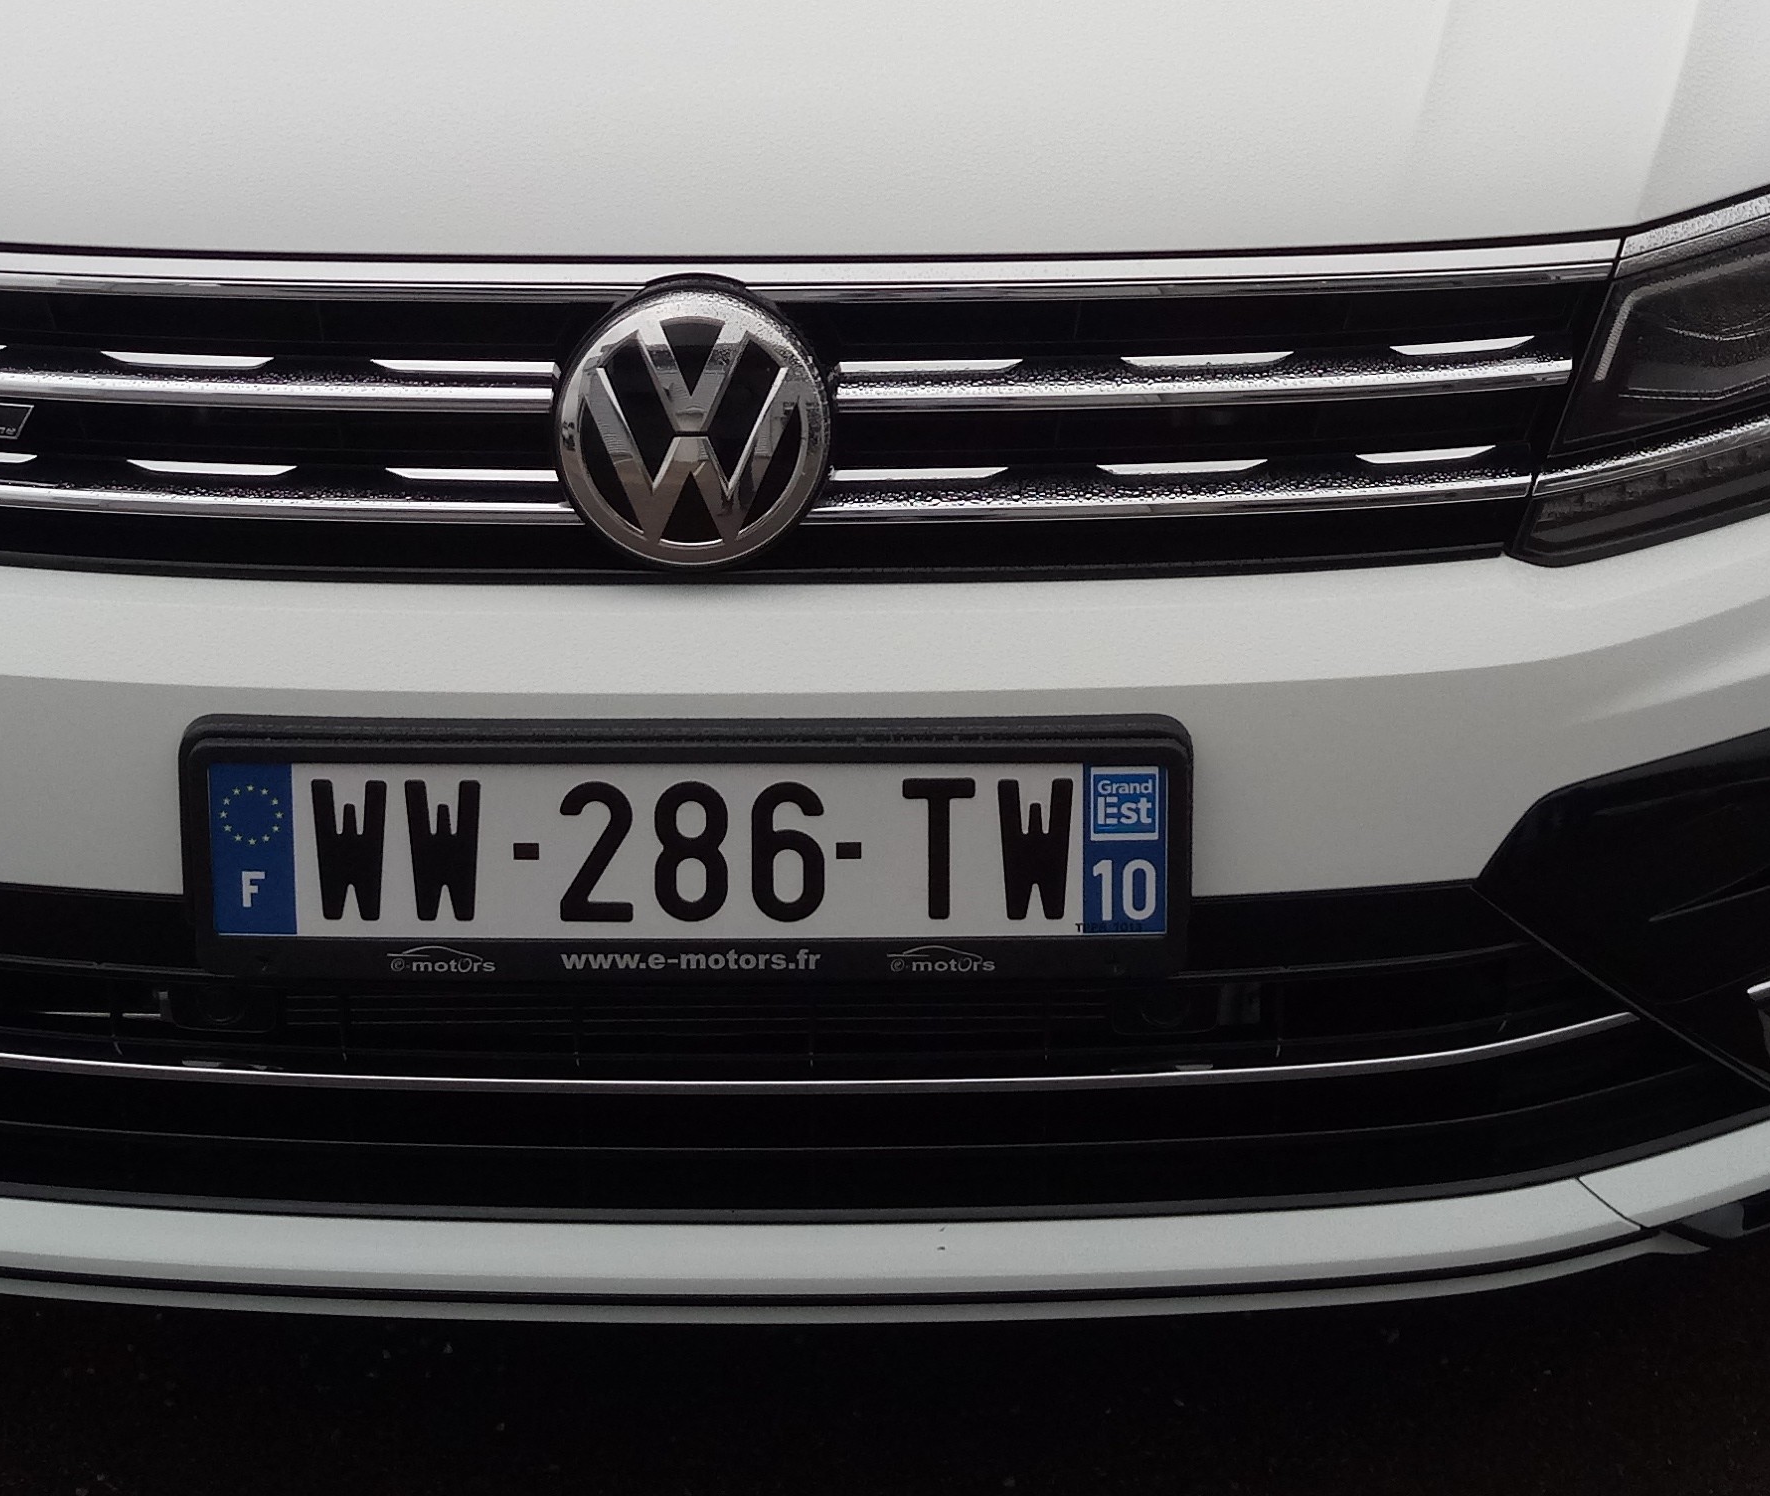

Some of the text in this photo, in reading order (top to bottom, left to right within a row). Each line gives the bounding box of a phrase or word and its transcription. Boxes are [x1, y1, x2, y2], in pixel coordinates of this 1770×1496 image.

[1097, 779, 1154, 795] Grand
[1097, 796, 1153, 825] Est
[242, 870, 266, 908] F
[1092, 859, 1157, 921] 10
[561, 949, 822, 971] www.e-motors.fr
